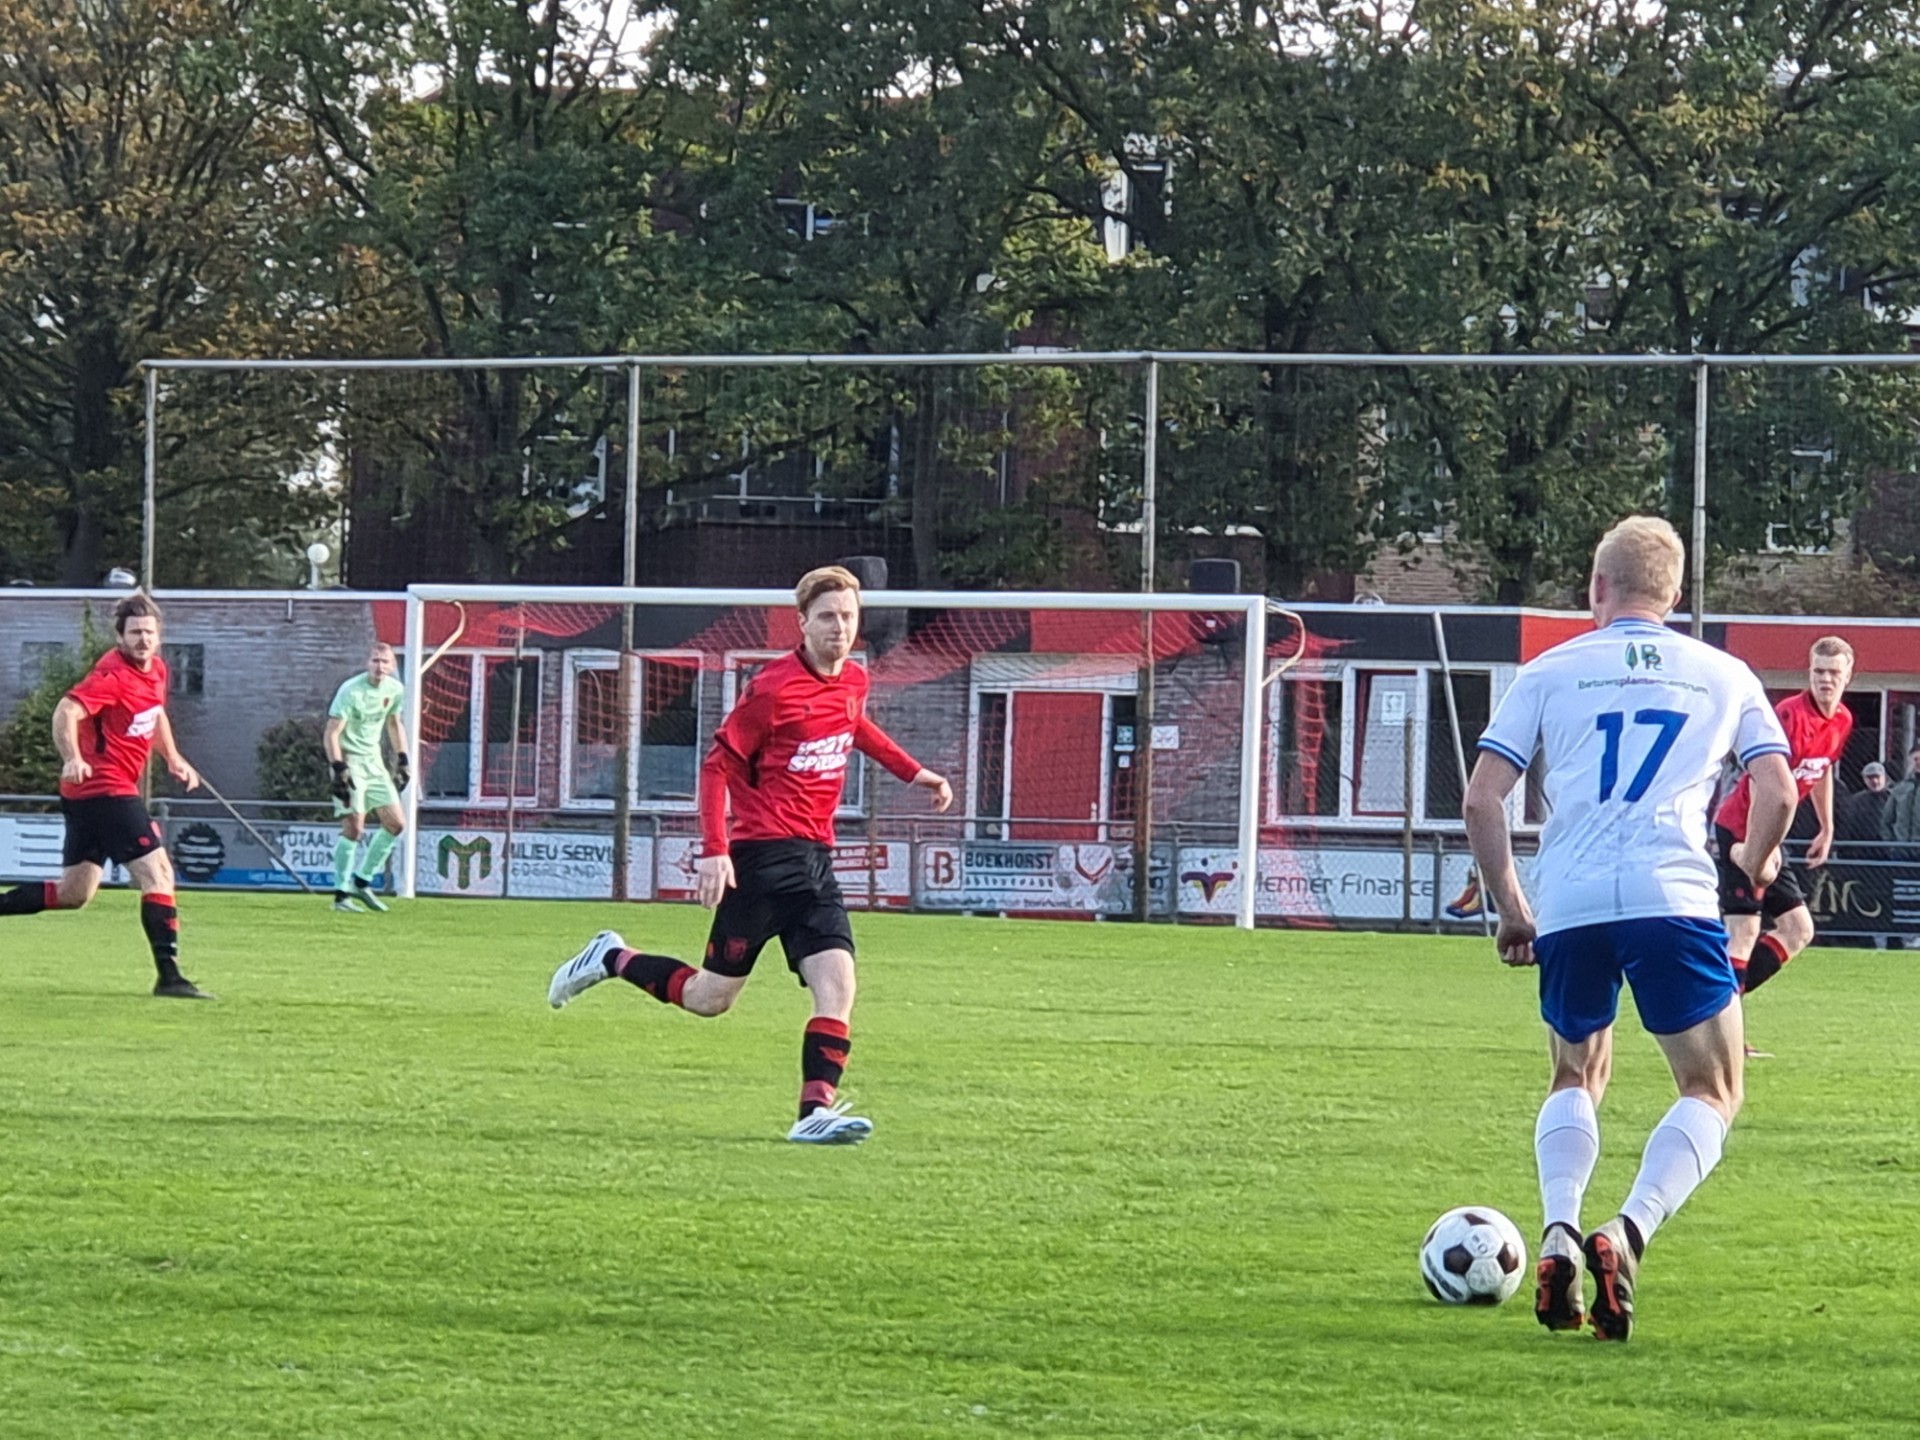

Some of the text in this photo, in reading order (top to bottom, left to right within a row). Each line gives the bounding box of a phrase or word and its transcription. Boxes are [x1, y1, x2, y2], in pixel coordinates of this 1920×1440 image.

[1596, 708, 1691, 805] 17
[510, 842, 558, 861] ILIEU
[964, 851, 1053, 870] BOEKHORST
[1340, 873, 1433, 897] Finance
